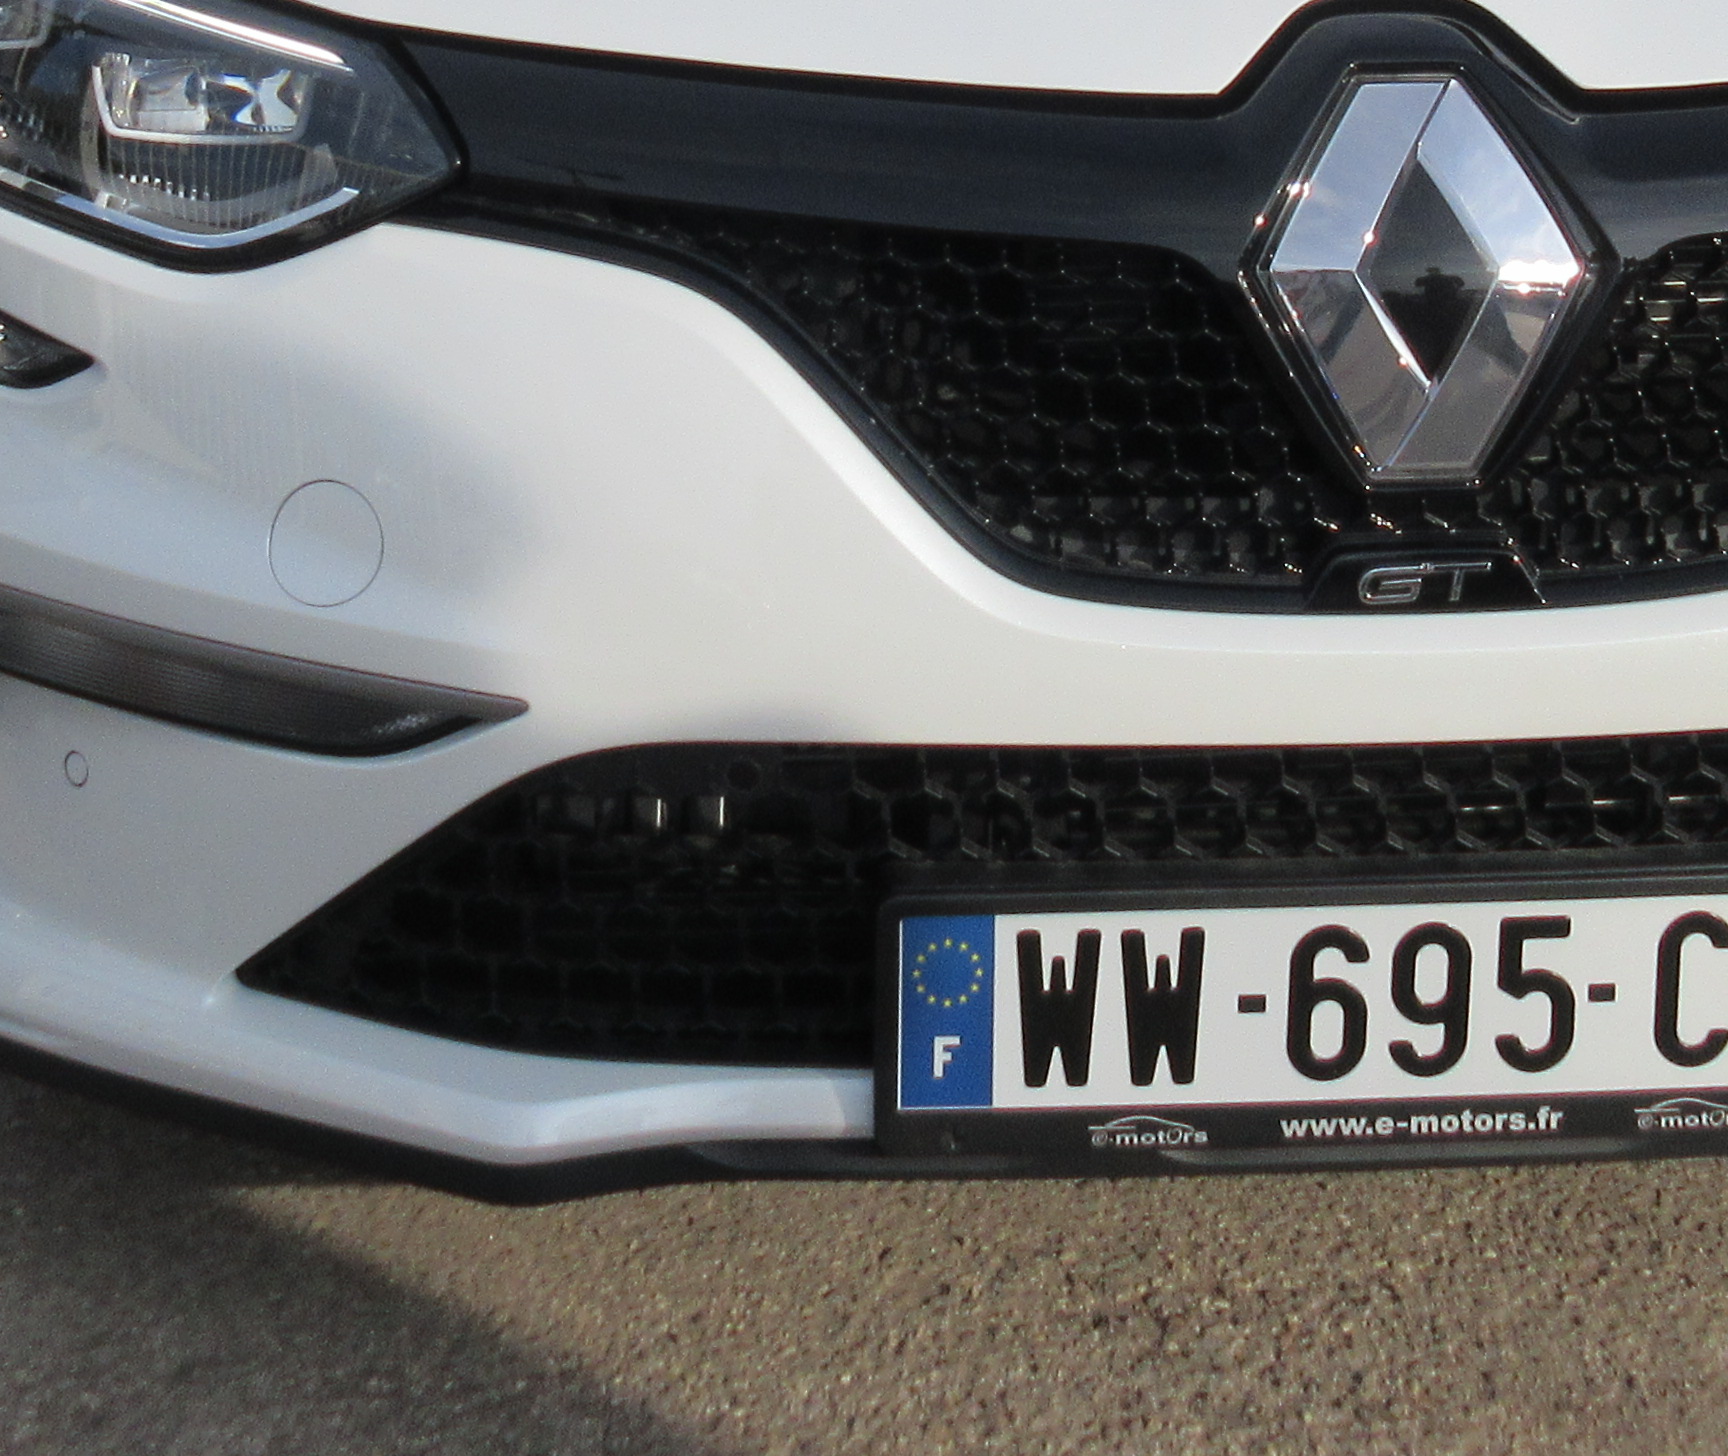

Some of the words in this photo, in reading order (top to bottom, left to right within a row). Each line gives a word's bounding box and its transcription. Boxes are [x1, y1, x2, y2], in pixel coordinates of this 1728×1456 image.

[1359, 561, 1492, 605] GT
[932, 1036, 961, 1078] F
[1279, 1106, 1565, 1138] www.e-motors.fr
